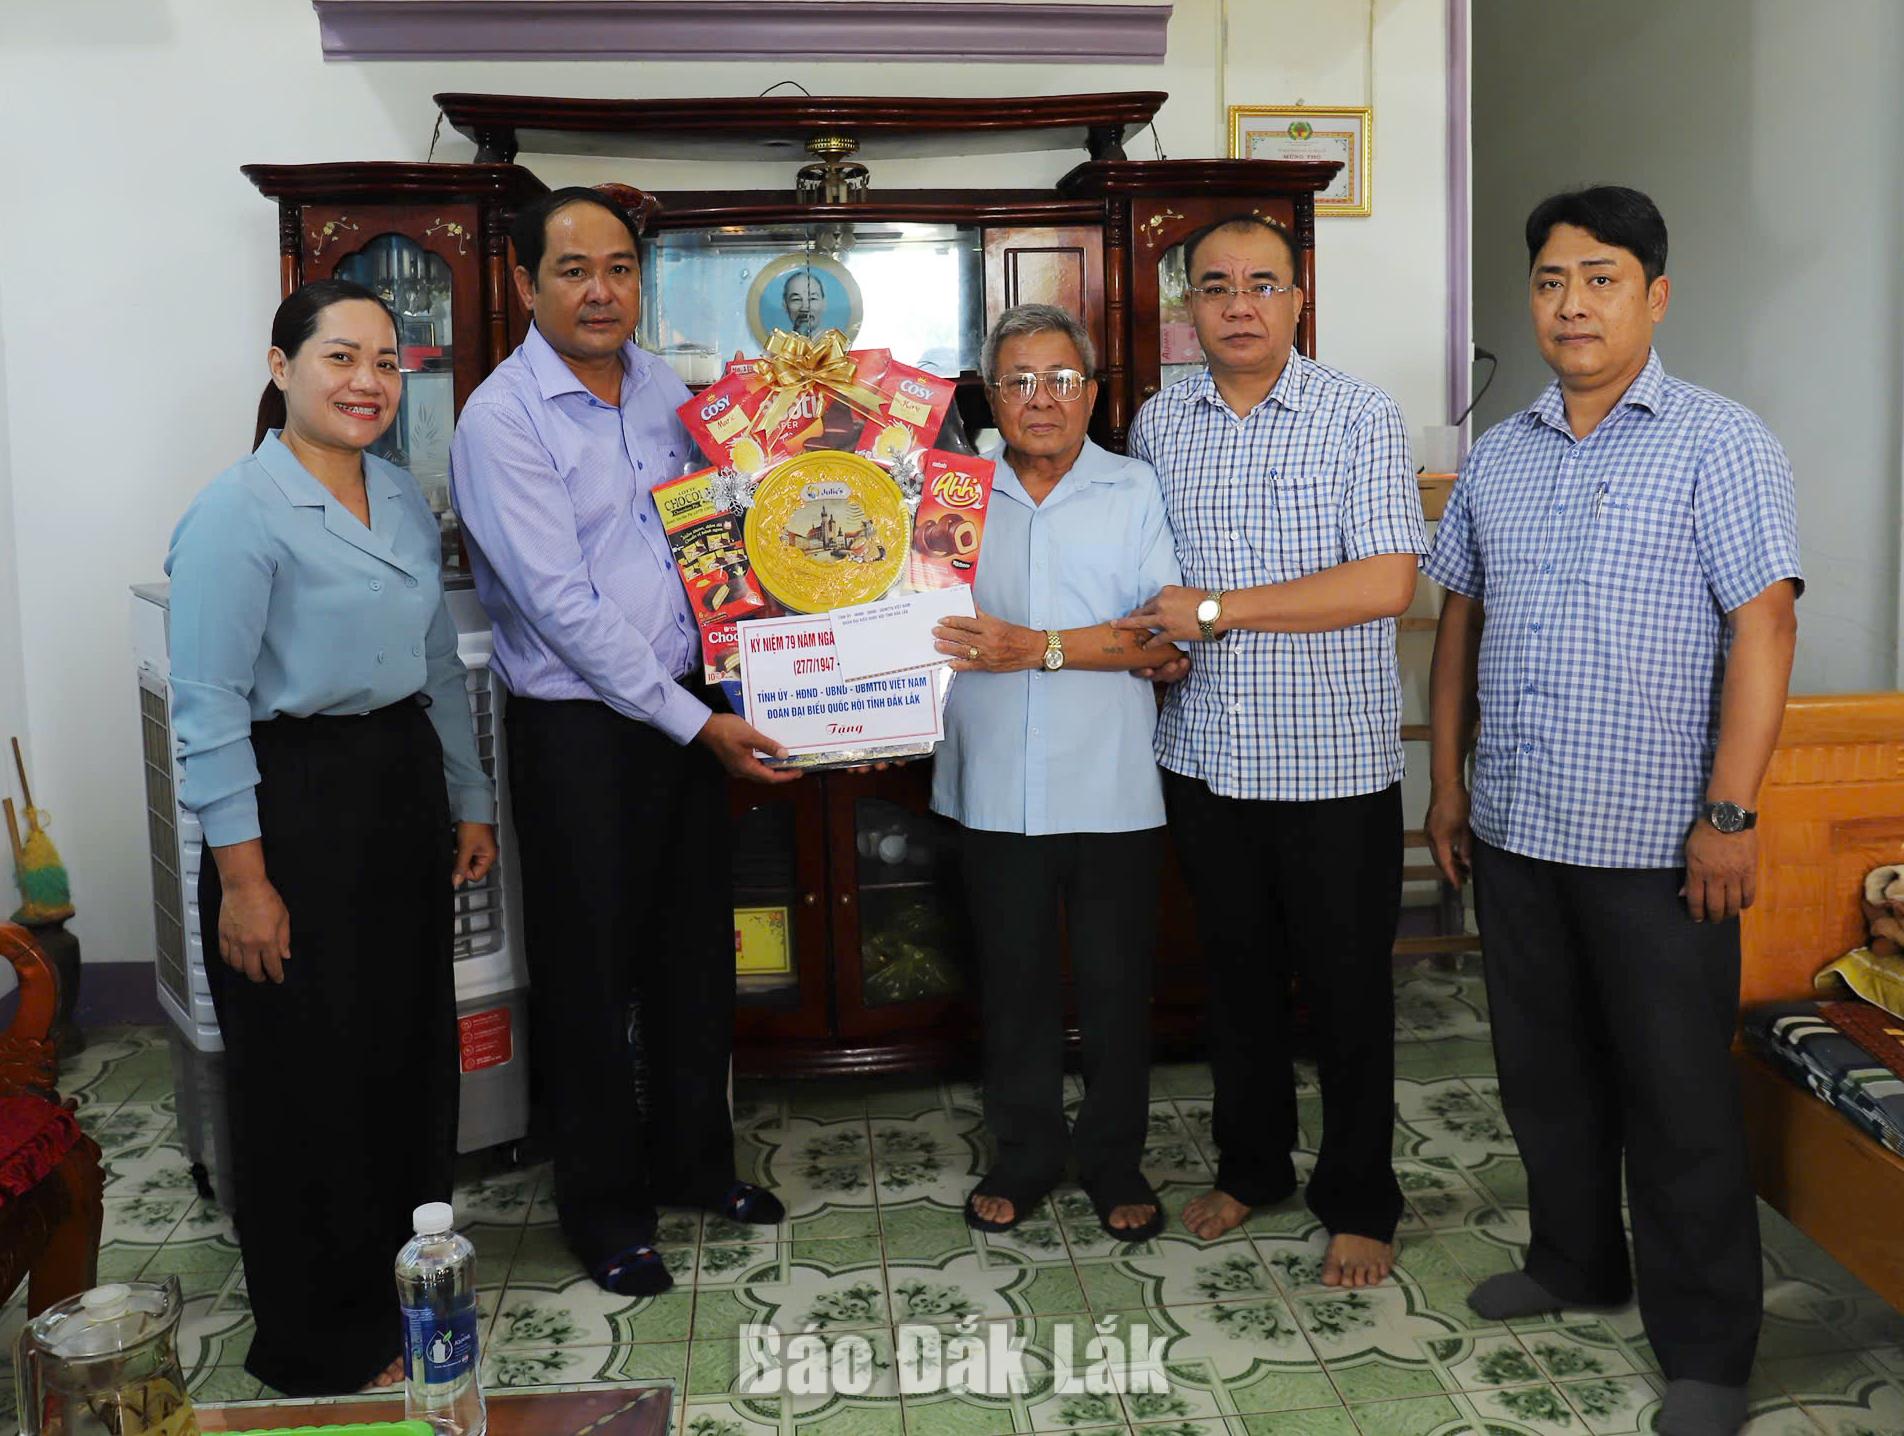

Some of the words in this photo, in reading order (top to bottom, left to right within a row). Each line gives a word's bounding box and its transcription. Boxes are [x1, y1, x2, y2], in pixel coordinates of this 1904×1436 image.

[900, 380, 935, 400] COSY
[700, 394, 731, 421] COSY
[763, 634, 784, 655] NIỆM
[785, 635, 796, 650] 79
[797, 631, 817, 648] NĂM
[793, 657, 835, 676] (27/7/1947
[757, 688, 776, 704] TỈNH
[795, 687, 818, 700] HĐND
[889, 676, 906, 691] VIỆT
[908, 676, 927, 688] NAM
[867, 695, 885, 710] TỈNH
